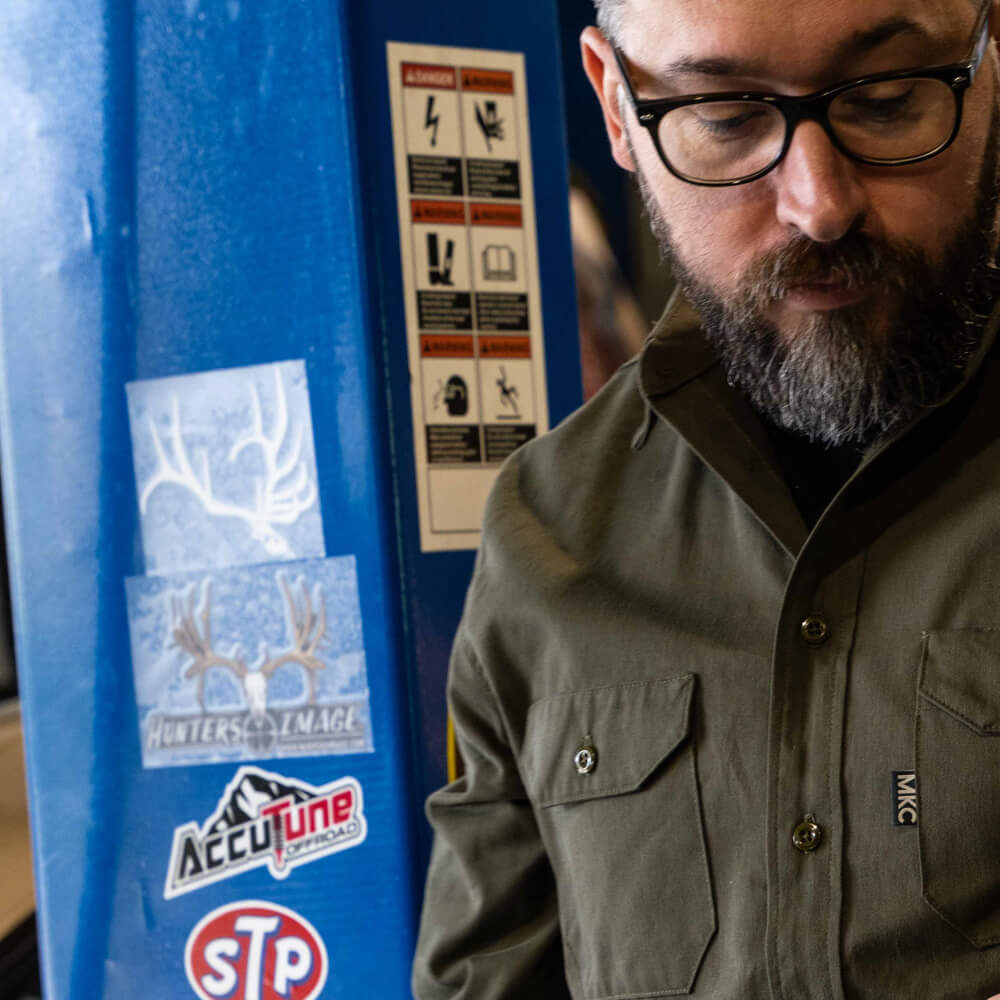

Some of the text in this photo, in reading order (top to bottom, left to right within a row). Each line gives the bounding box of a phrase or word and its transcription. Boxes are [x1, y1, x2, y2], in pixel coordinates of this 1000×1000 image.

[148, 714, 242, 747] HUNTERS
[279, 706, 360, 736] IMAGE
[897, 774, 917, 824] MKC
[285, 821, 358, 858] OFFROAD
